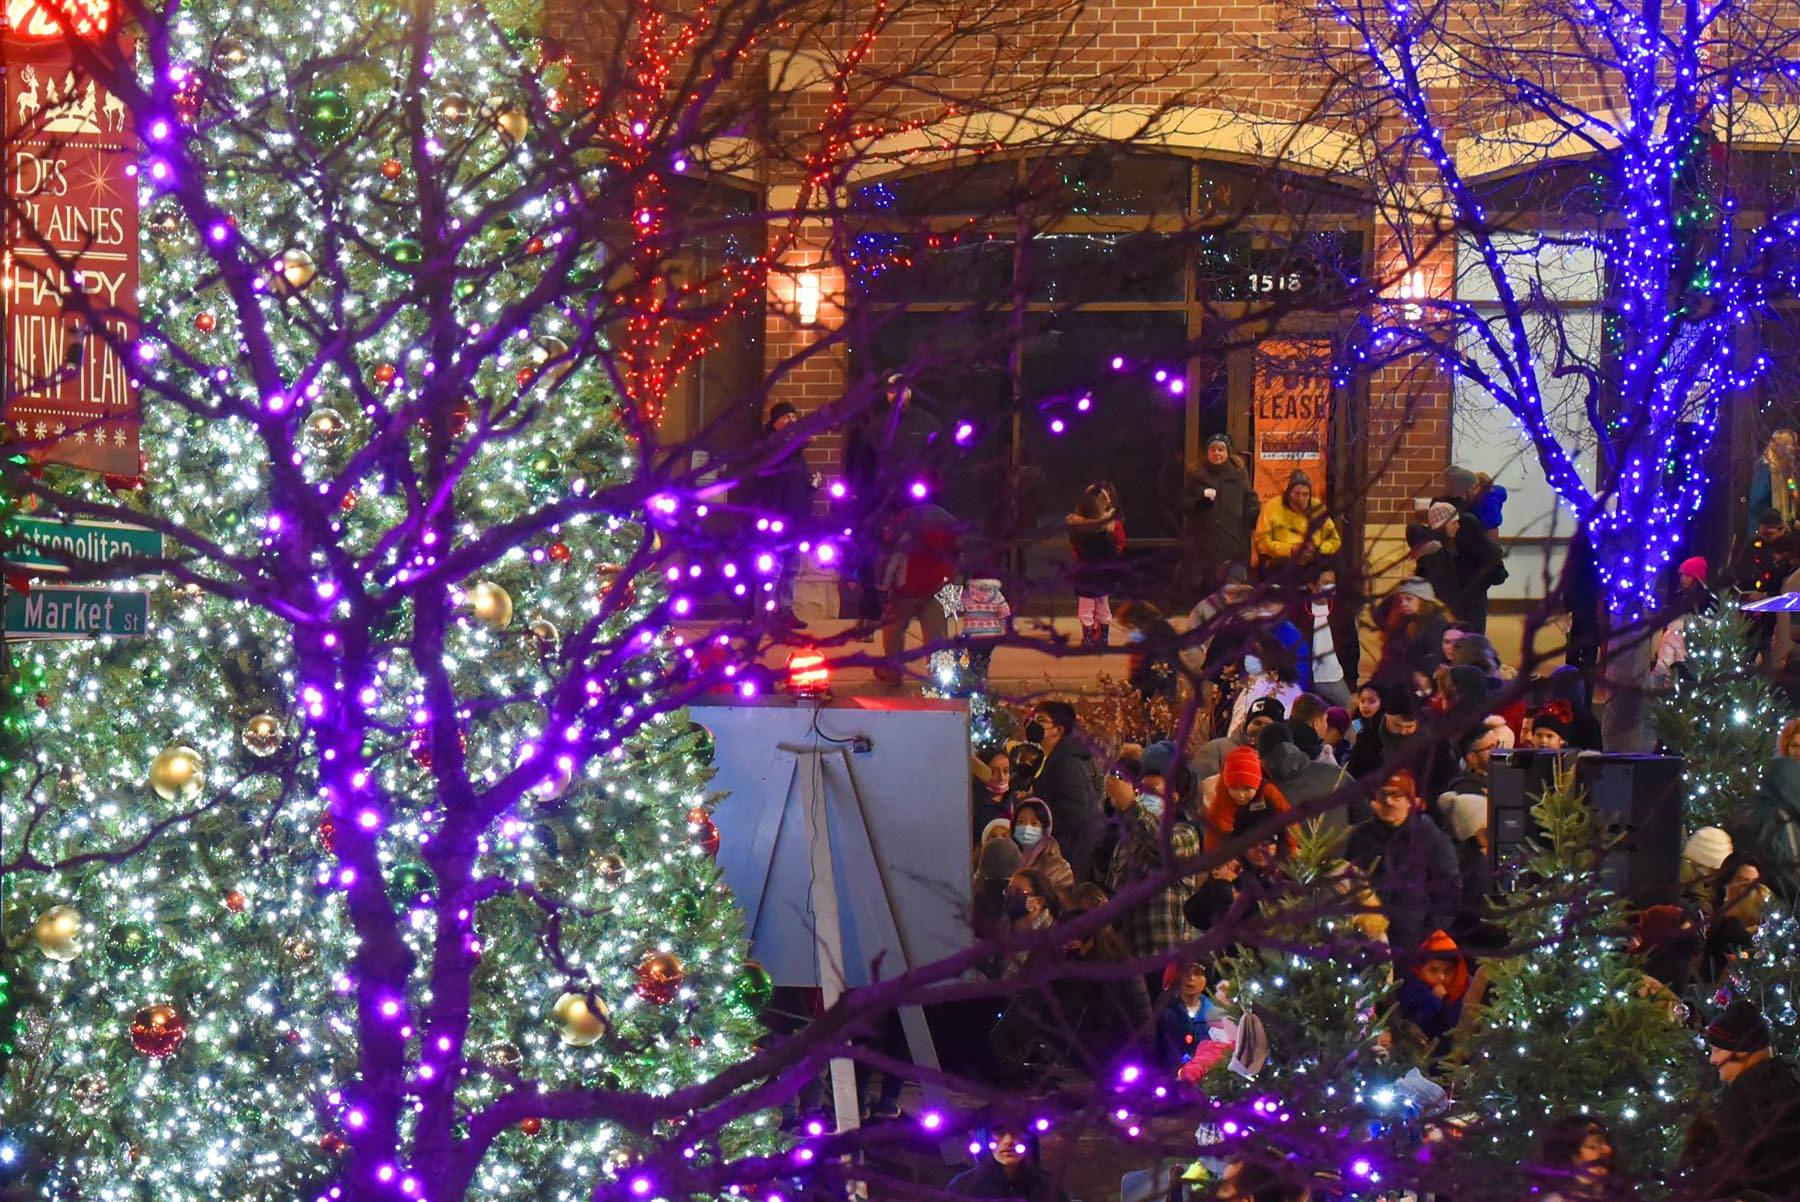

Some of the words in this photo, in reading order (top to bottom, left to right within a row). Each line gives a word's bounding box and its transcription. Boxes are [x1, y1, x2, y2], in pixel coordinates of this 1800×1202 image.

[15, 151, 67, 197] DES
[14, 199, 124, 245] PLAINES
[14, 314, 65, 400] NEW
[1258, 395, 1326, 420] LEASE
[11, 525, 132, 564] etropolitan
[24, 593, 114, 630] Market
[123, 613, 138, 631] St
